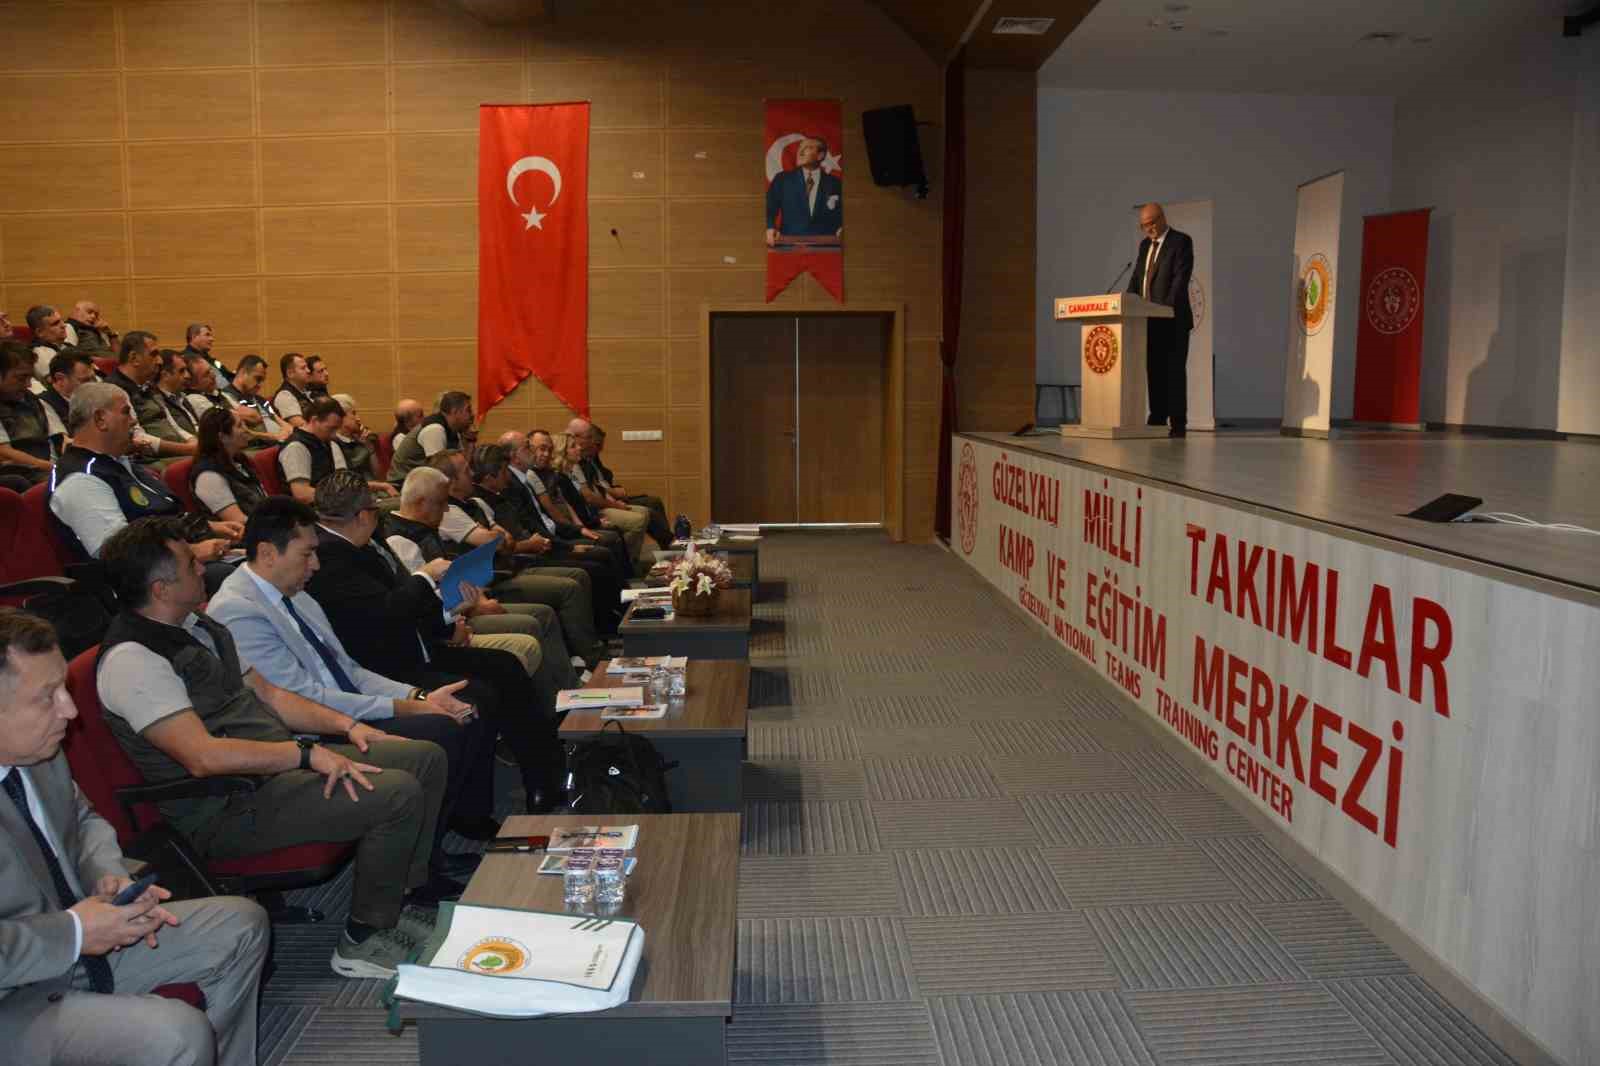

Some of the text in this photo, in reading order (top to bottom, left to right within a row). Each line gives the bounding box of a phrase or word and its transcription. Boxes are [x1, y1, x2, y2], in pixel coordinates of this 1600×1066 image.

[999, 523, 1405, 850] KAMP VE EĞİTİM MERKEZİ
[1054, 614, 1097, 664] NATIONAL
[1105, 651, 1142, 700] TEAMS
[1156, 687, 1219, 761] TRAINING
[1226, 741, 1293, 824] CENTER
[1083, 478, 1142, 568] MİLLİ
[1185, 522, 1453, 719] TAKIMLAR
